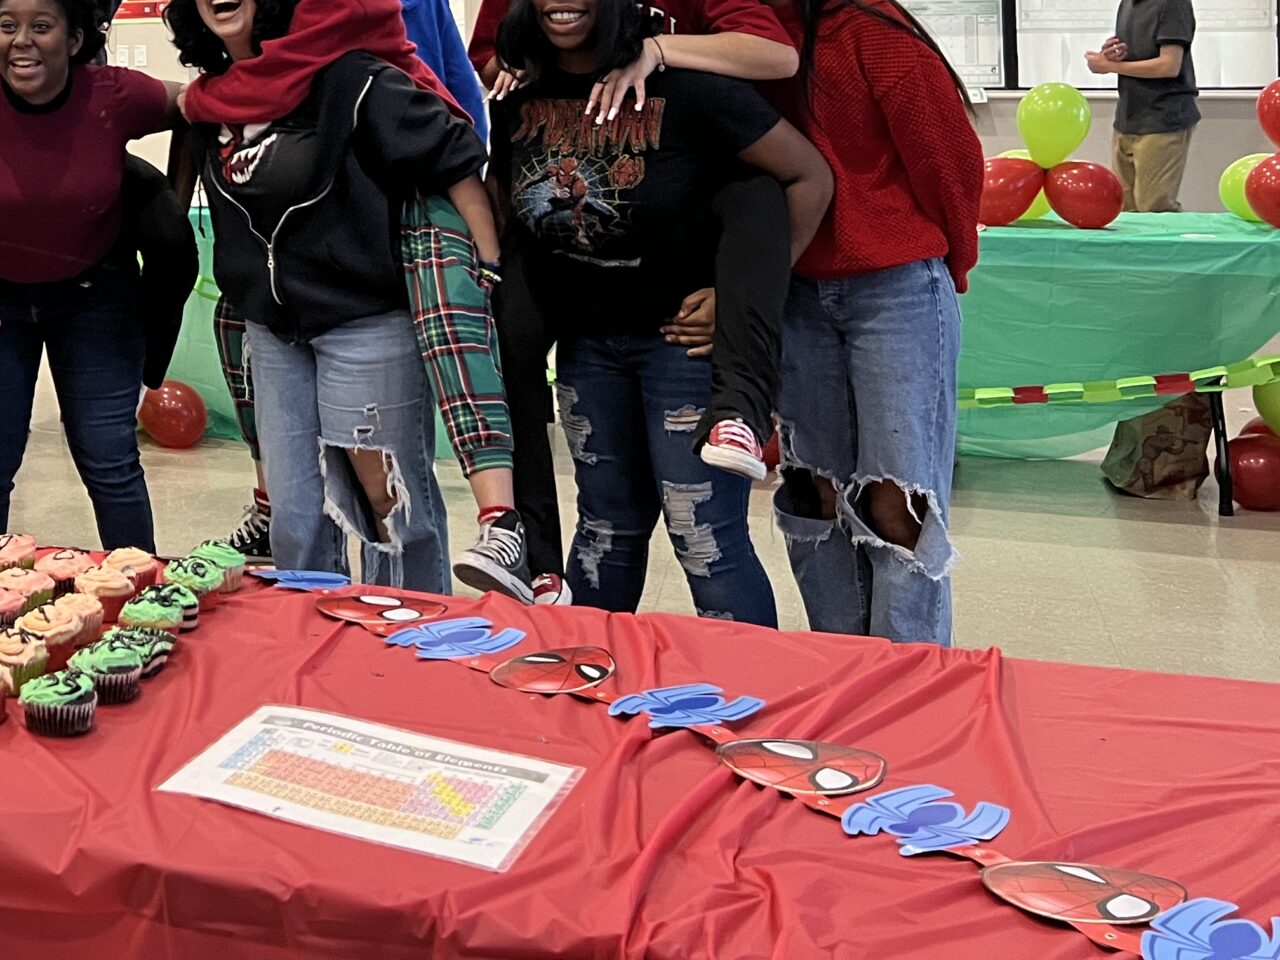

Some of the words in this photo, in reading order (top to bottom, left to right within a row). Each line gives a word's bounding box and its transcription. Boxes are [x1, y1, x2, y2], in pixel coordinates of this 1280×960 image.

[301, 721, 365, 743] Periodic
[369, 736, 411, 756] Table
[414, 746, 433, 759] of
[435, 753, 509, 775] Elements
